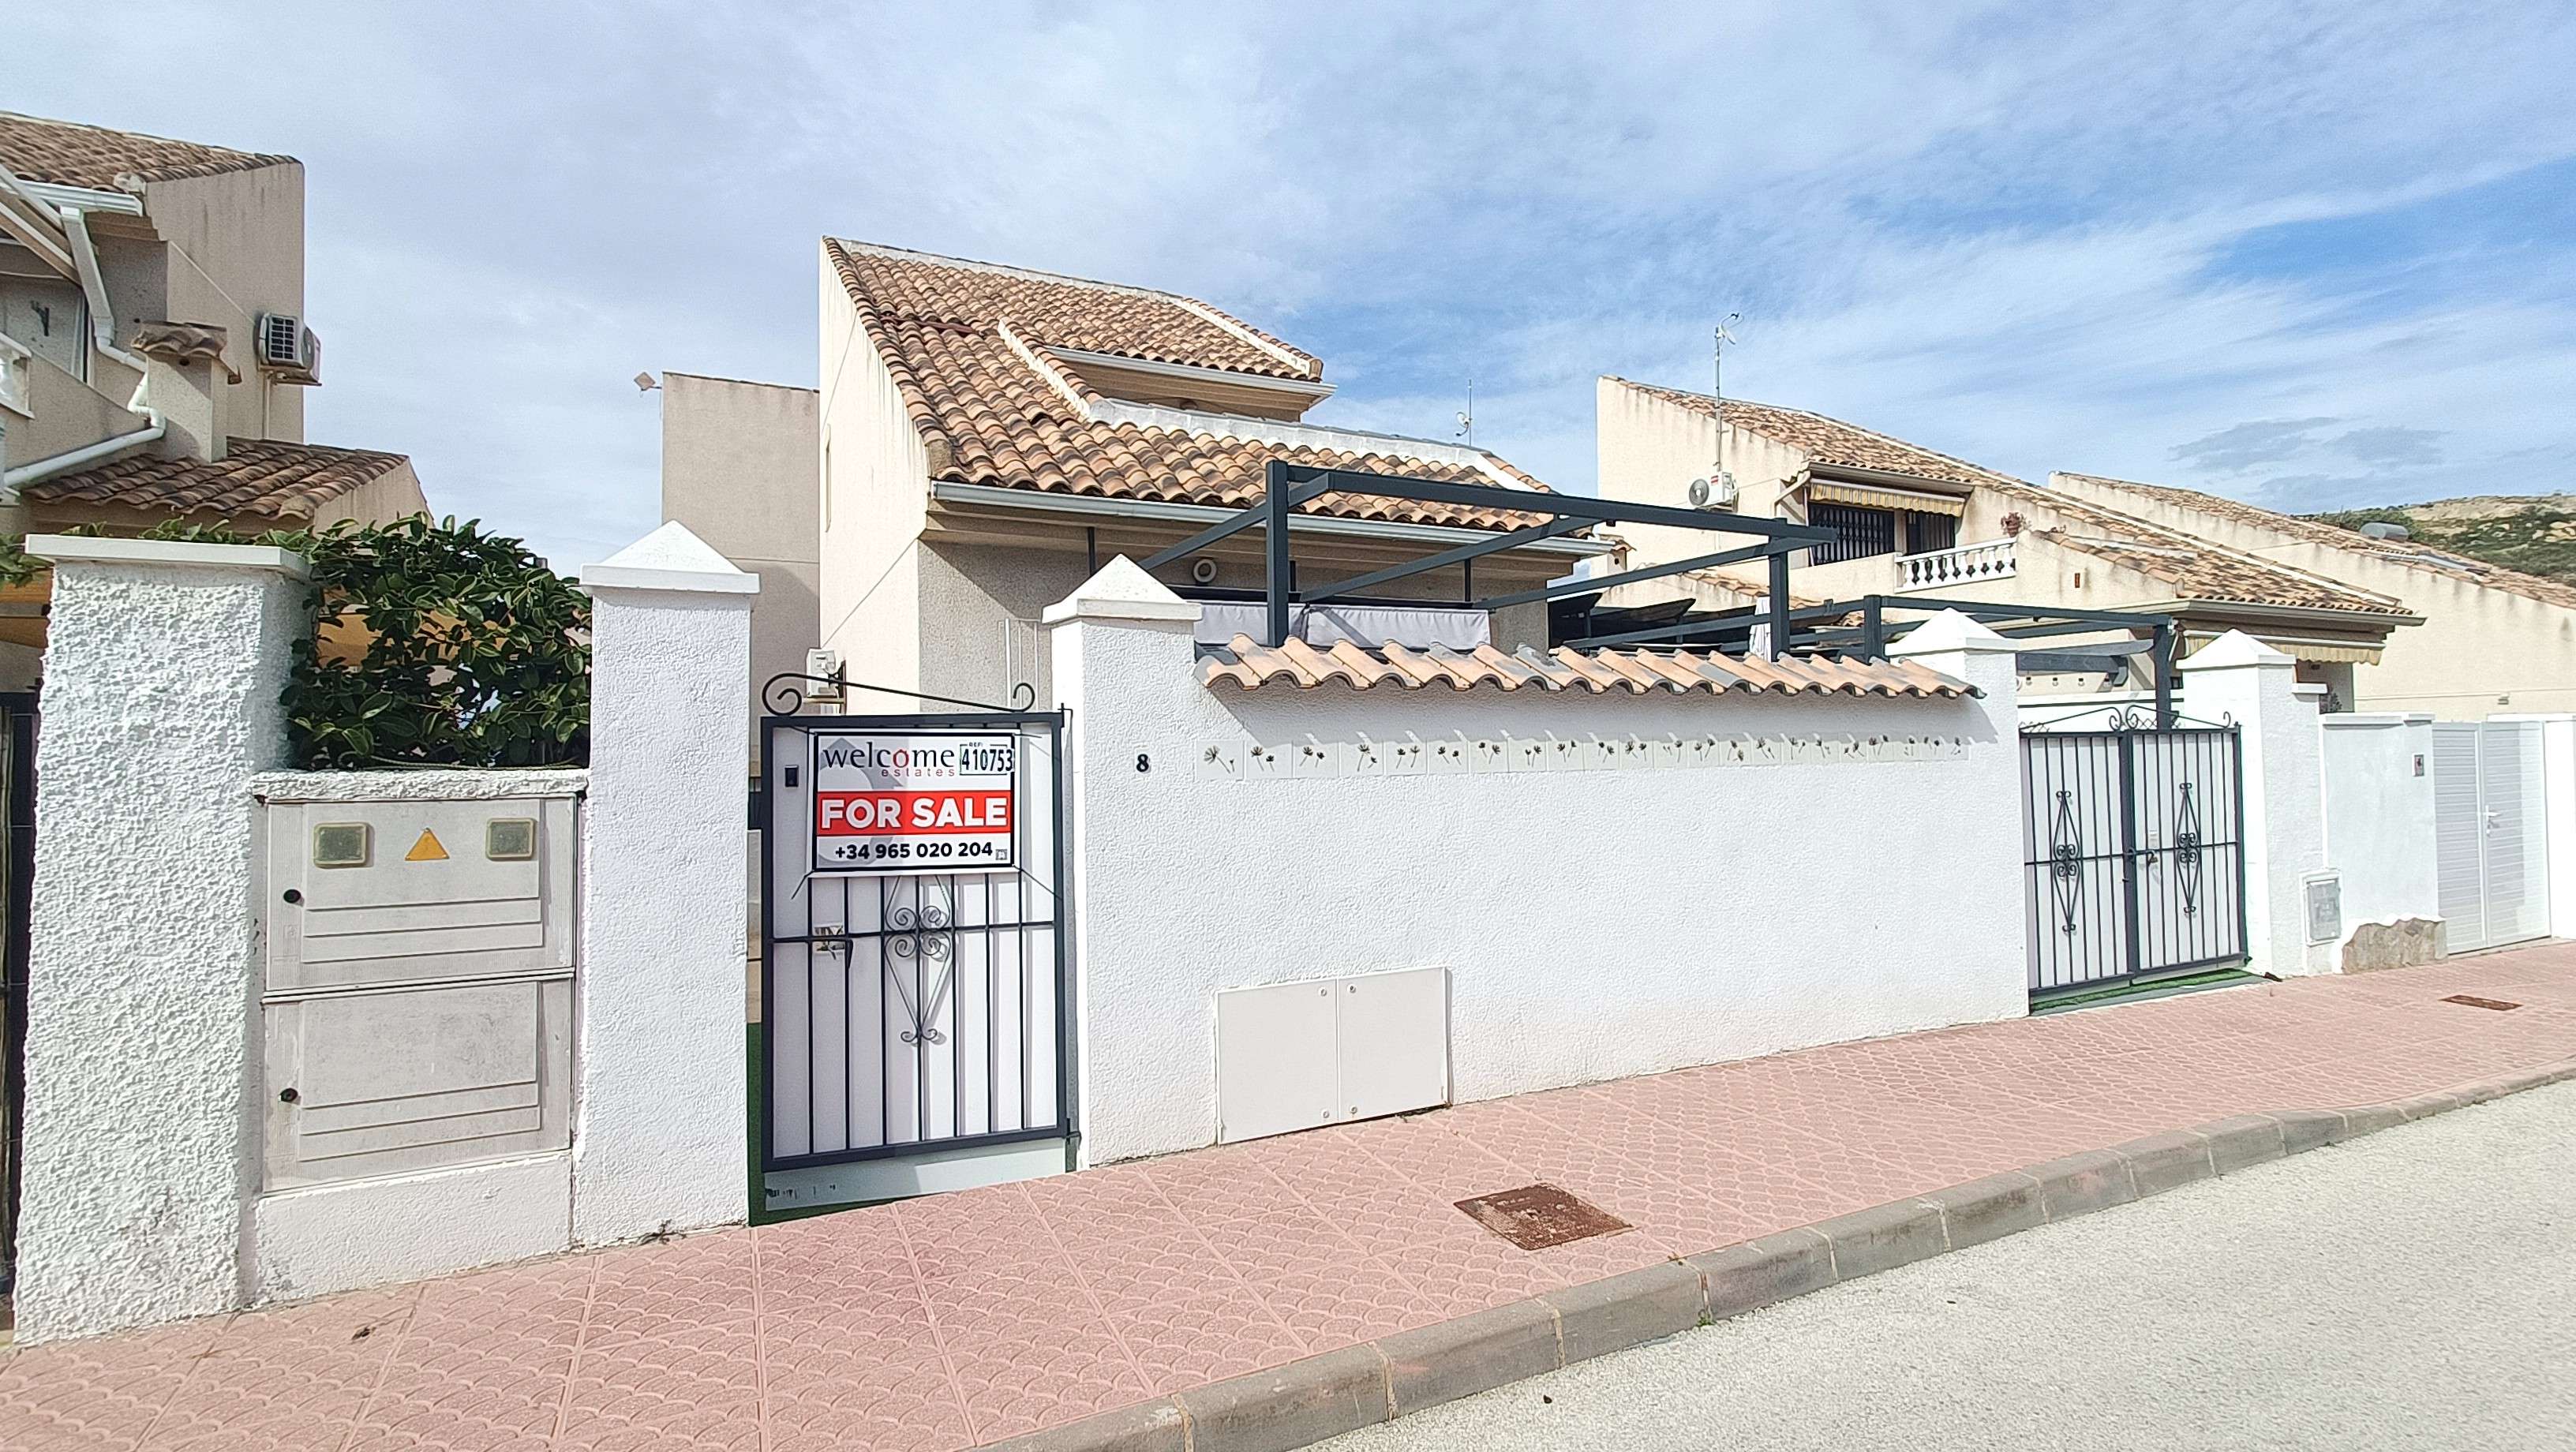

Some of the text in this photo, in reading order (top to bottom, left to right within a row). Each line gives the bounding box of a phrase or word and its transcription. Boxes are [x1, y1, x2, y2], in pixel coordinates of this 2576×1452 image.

[823, 742, 955, 768] welcome
[961, 749, 1013, 772] 410753
[1136, 754, 1149, 773] 8
[882, 768, 955, 777] estates
[822, 797, 1008, 829] FOR SALE
[835, 842, 993, 859] +34 965 020 204
